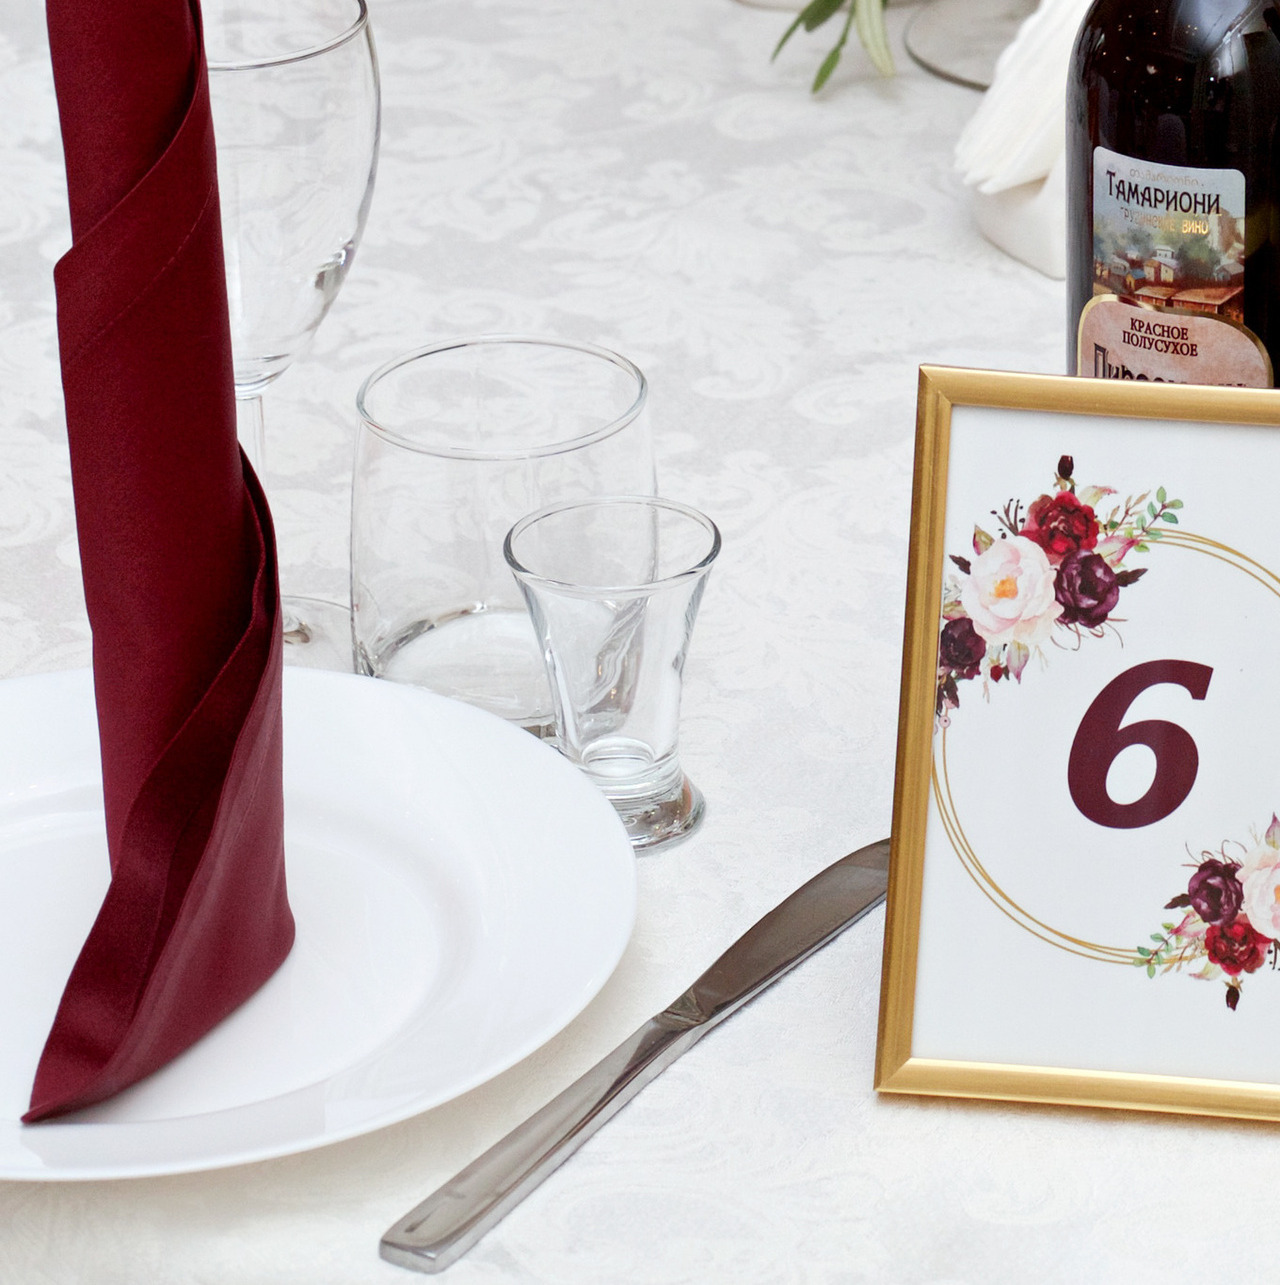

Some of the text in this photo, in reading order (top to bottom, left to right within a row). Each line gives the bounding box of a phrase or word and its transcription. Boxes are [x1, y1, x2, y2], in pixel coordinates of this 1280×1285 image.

[1106, 169, 1221, 215] ТАМАРИОНИ
[1181, 219, 1209, 235] ВИНО
[1130, 317, 1189, 341] КРАСНОЕ
[1122, 330, 1198, 357] ПОЛУСУХОЕ
[1067, 658, 1214, 830] 6
